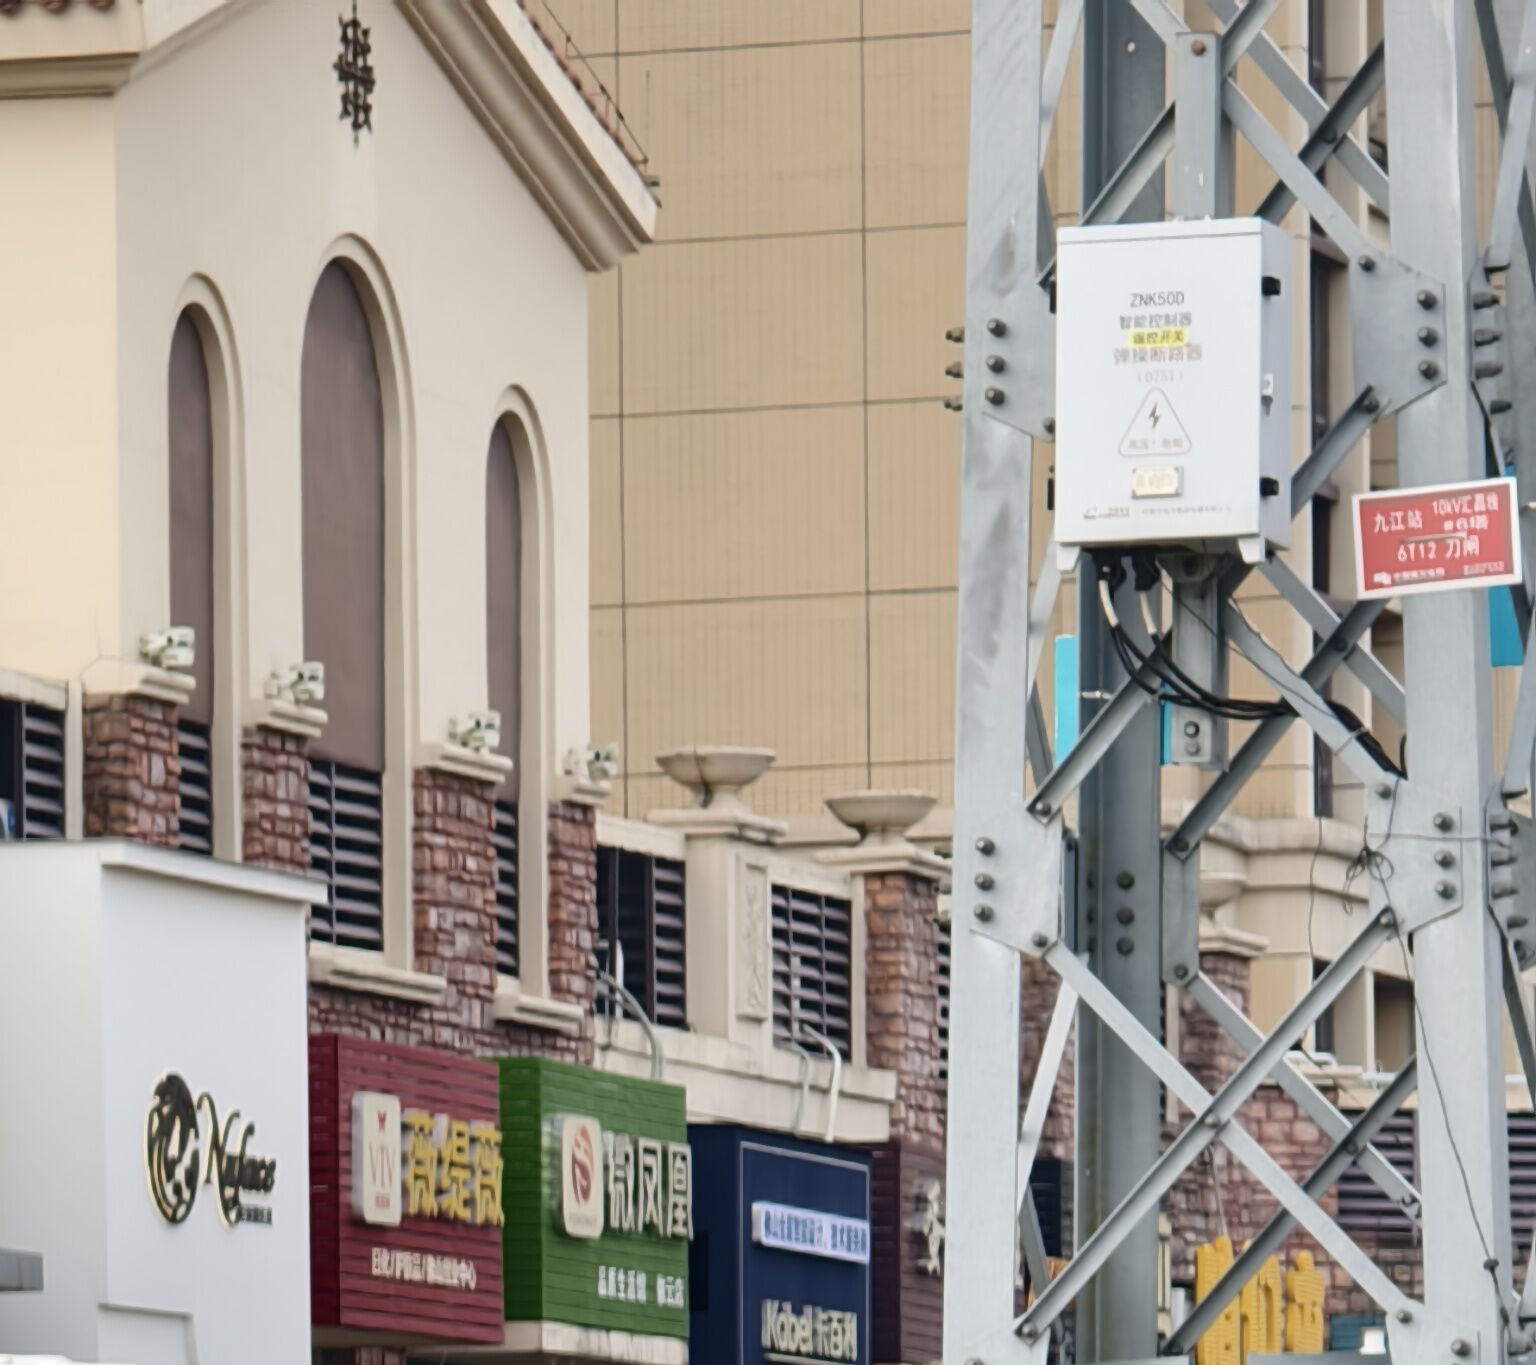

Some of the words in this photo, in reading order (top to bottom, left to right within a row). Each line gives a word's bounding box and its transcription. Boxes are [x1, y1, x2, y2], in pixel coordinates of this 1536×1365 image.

[1374, 510, 1423, 533] 九江站
[1397, 541, 1437, 562] 6T12
[606, 1133, 694, 1242] 微凤凰
